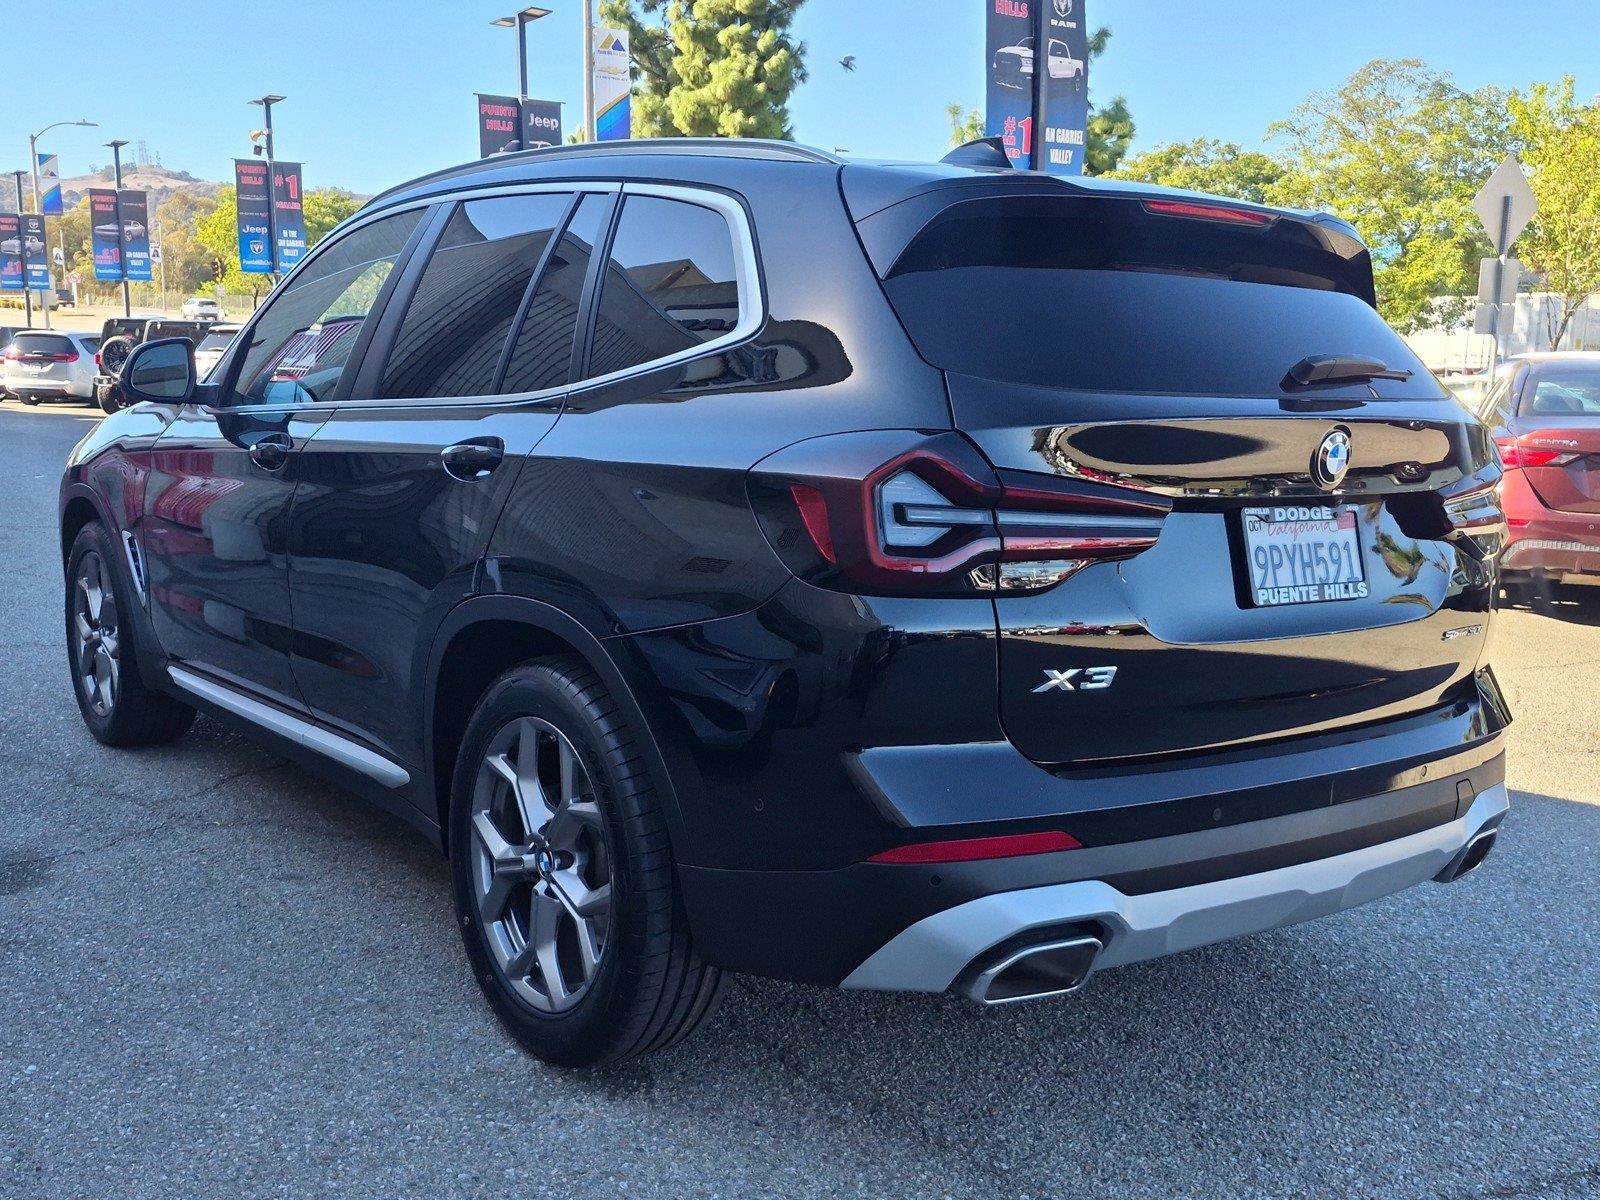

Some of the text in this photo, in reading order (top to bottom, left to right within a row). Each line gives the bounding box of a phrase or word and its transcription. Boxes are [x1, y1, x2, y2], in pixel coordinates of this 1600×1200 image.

[995, 0, 1028, 18] HILLS
[1050, 19, 1076, 28] RAM
[480, 104, 518, 117] PUENTE
[486, 119, 513, 131] HILLS
[529, 113, 559, 131] Jeep
[1055, 130, 1083, 145] GABRIEL
[1050, 149, 1073, 164] VALLEY
[274, 174, 298, 199] #1
[243, 224, 268, 235] Jeep
[1274, 506, 1333, 521] DODGE
[1248, 520, 1262, 532] OCT
[1267, 520, 1336, 541] California
[1254, 541, 1360, 588] 9PYH591
[1257, 581, 1369, 605] PUENTE HILLS
[1030, 666, 1118, 693] X3
